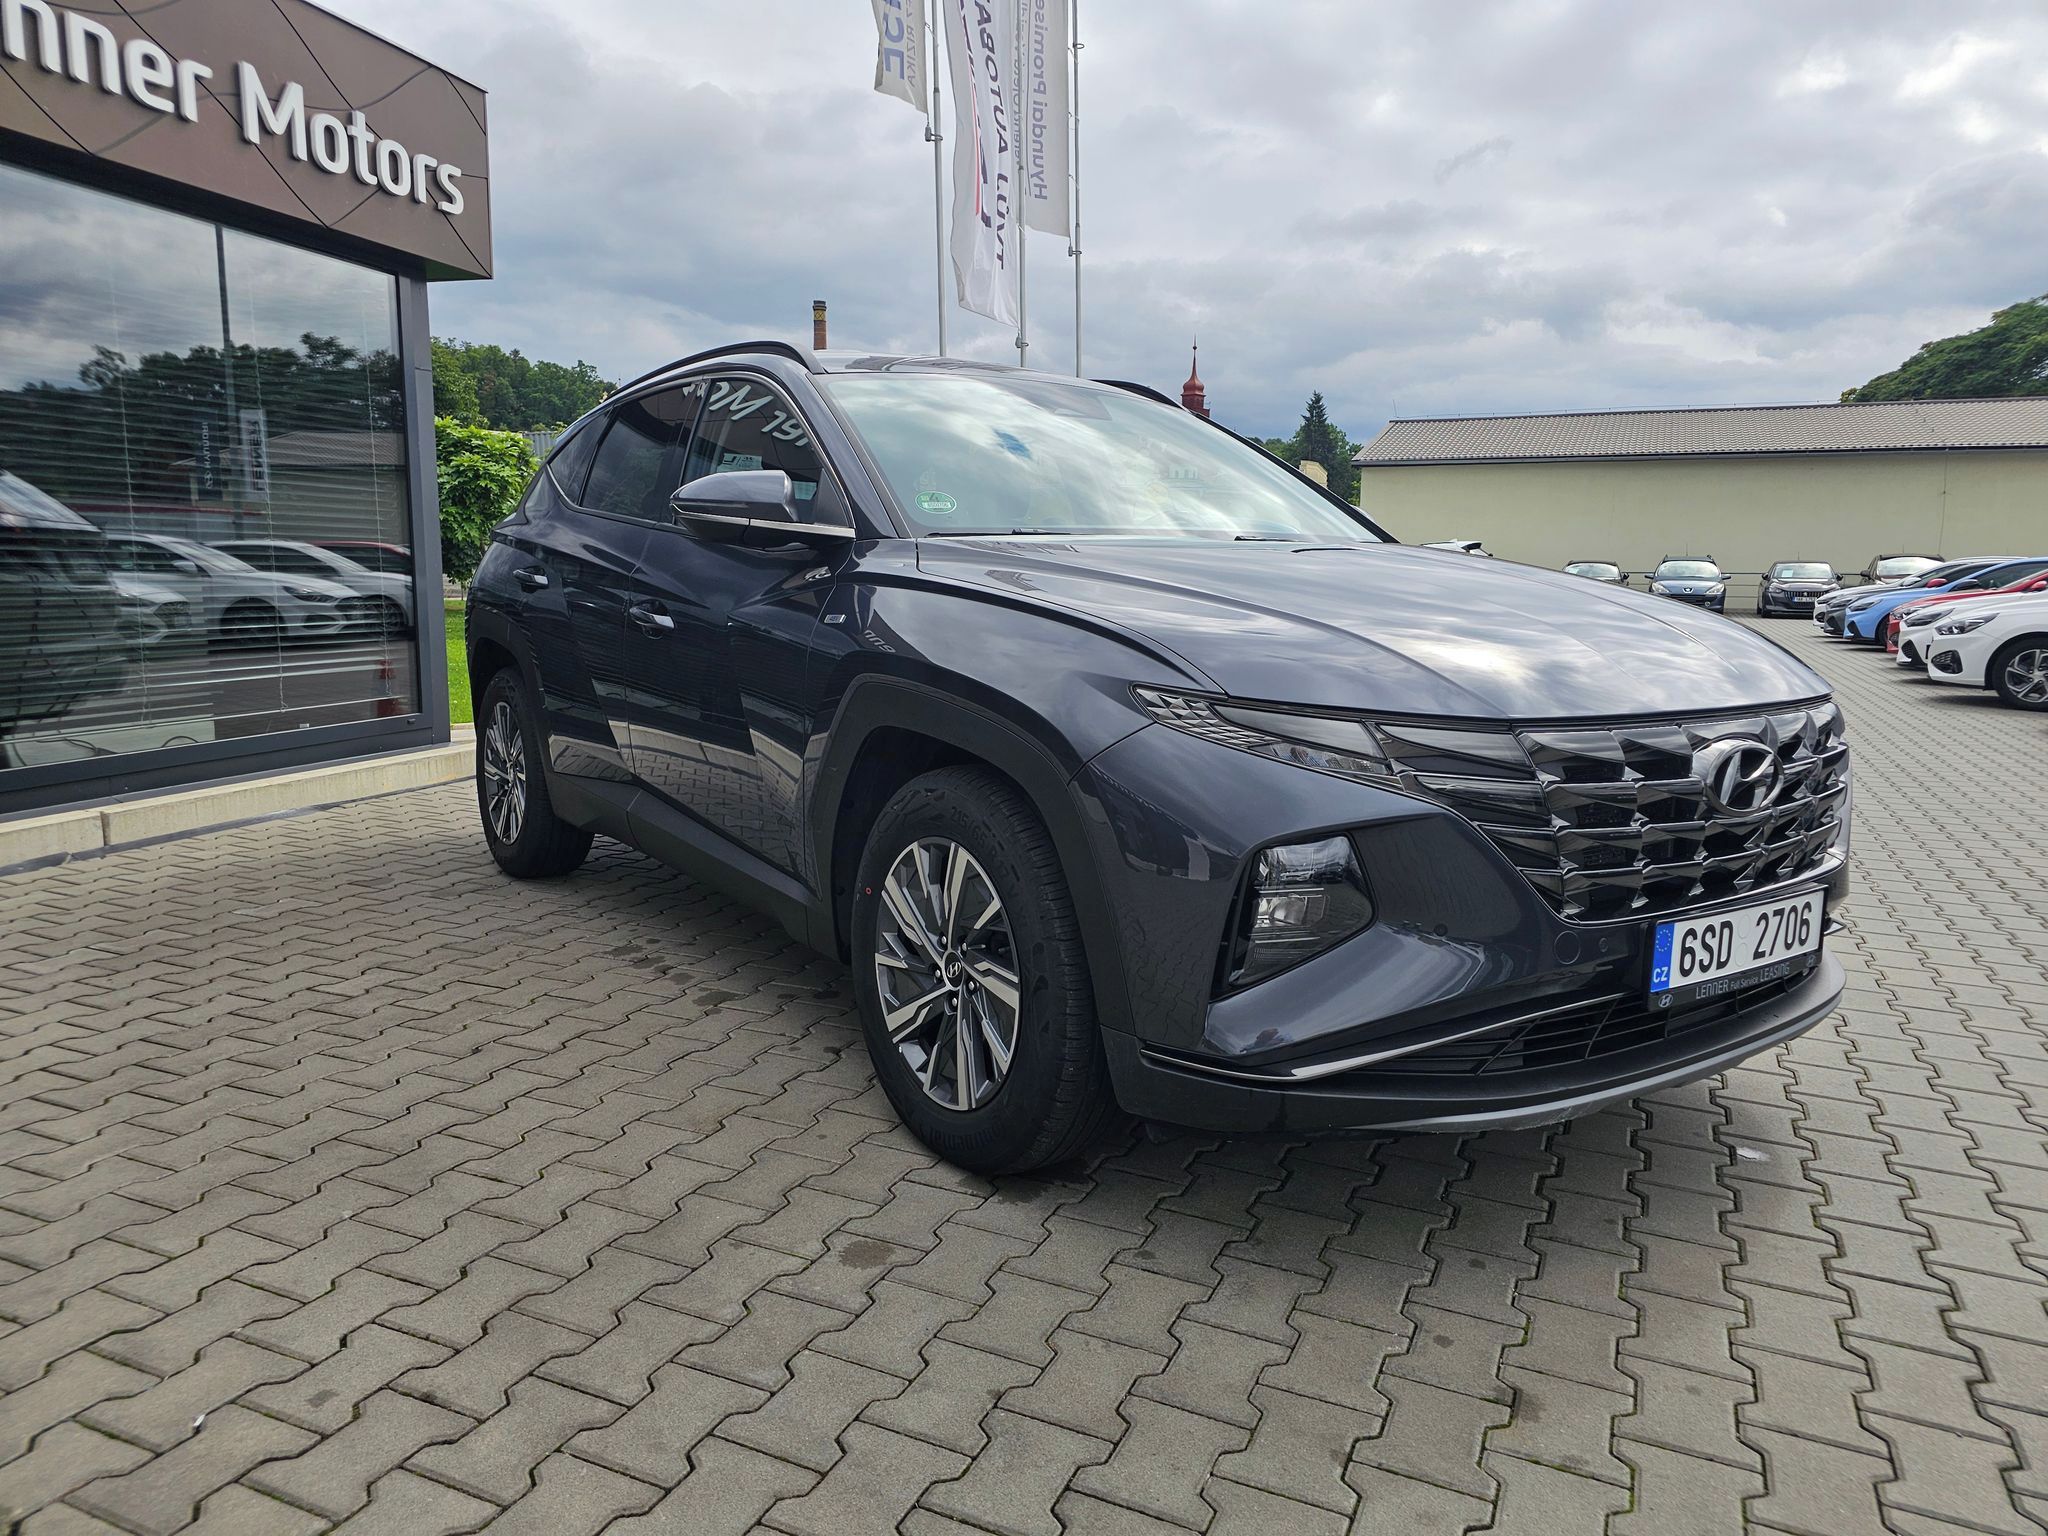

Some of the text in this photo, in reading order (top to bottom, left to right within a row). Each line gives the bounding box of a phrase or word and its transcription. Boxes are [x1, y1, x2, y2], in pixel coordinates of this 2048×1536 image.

[237, 60, 464, 215] Motors
[1679, 901, 1812, 978] 6SD 2706
[1653, 966, 1668, 983] CZ
[1696, 980, 1729, 999] LENNER
[1760, 962, 1790, 982] LEASING
